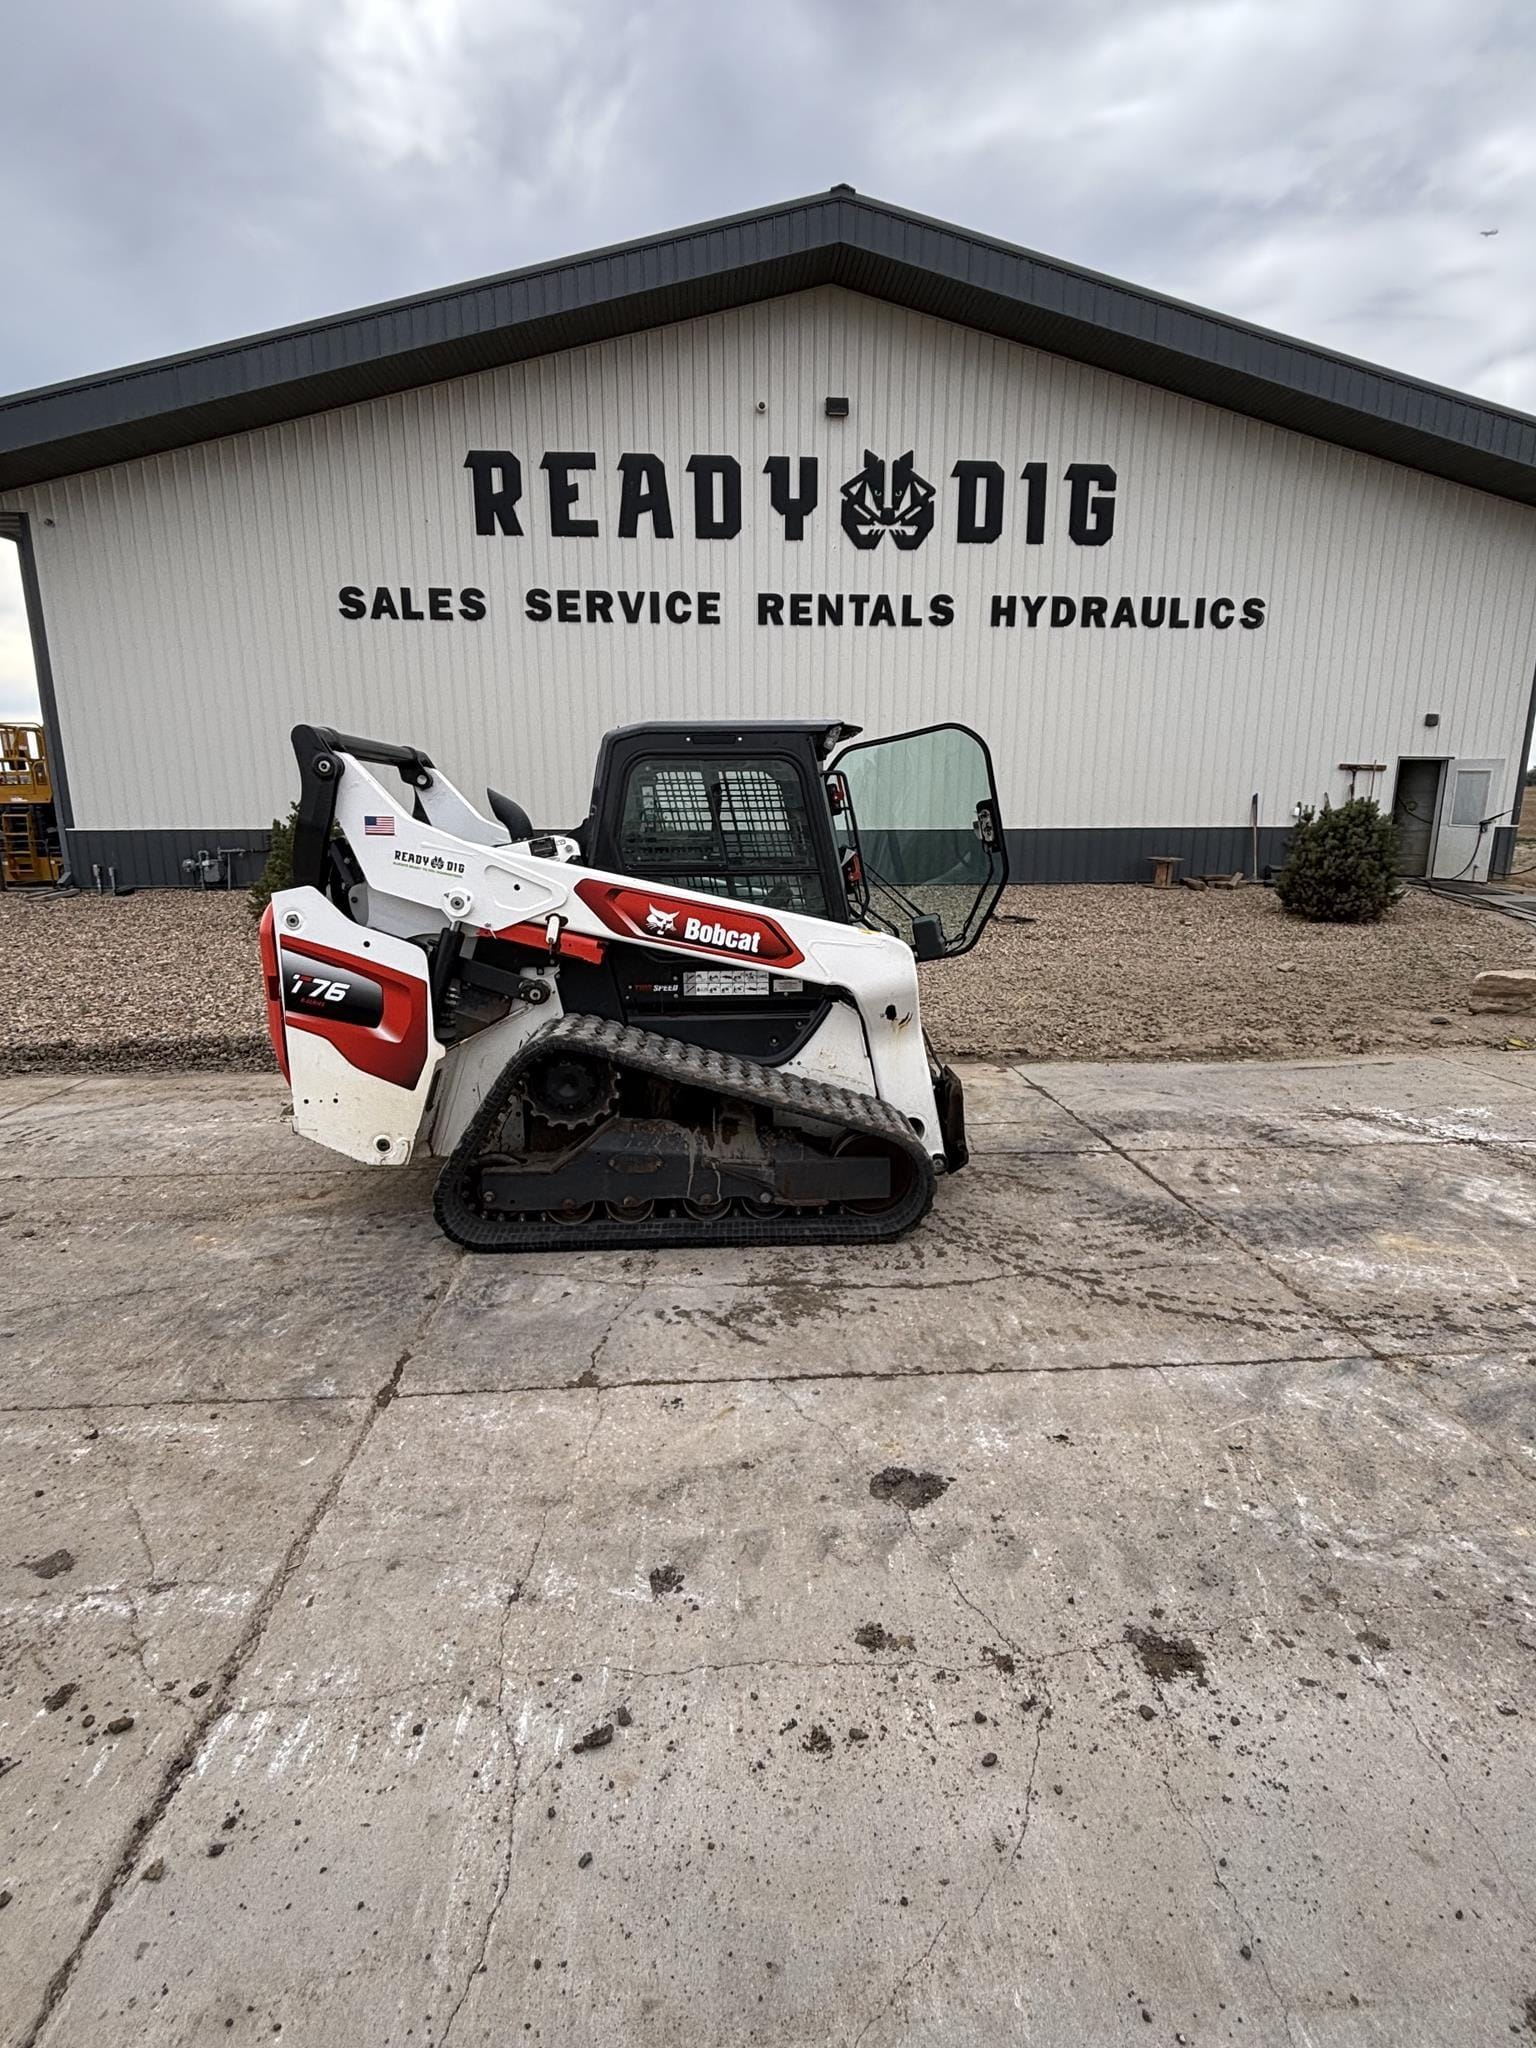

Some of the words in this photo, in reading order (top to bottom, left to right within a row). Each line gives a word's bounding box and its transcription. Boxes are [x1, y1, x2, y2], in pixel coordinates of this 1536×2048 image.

[463, 450, 819, 542] READY
[951, 460, 1118, 547] DIG
[339, 586, 487, 622] SALES
[525, 588, 721, 625] SERVICE
[758, 593, 955, 627] RENTALS
[990, 595, 1266, 630] HYDRAULICS
[394, 850, 430, 866] READY
[446, 861, 466, 874] DIG
[684, 917, 761, 953] Bobcat
[291, 973, 351, 1002] T76
